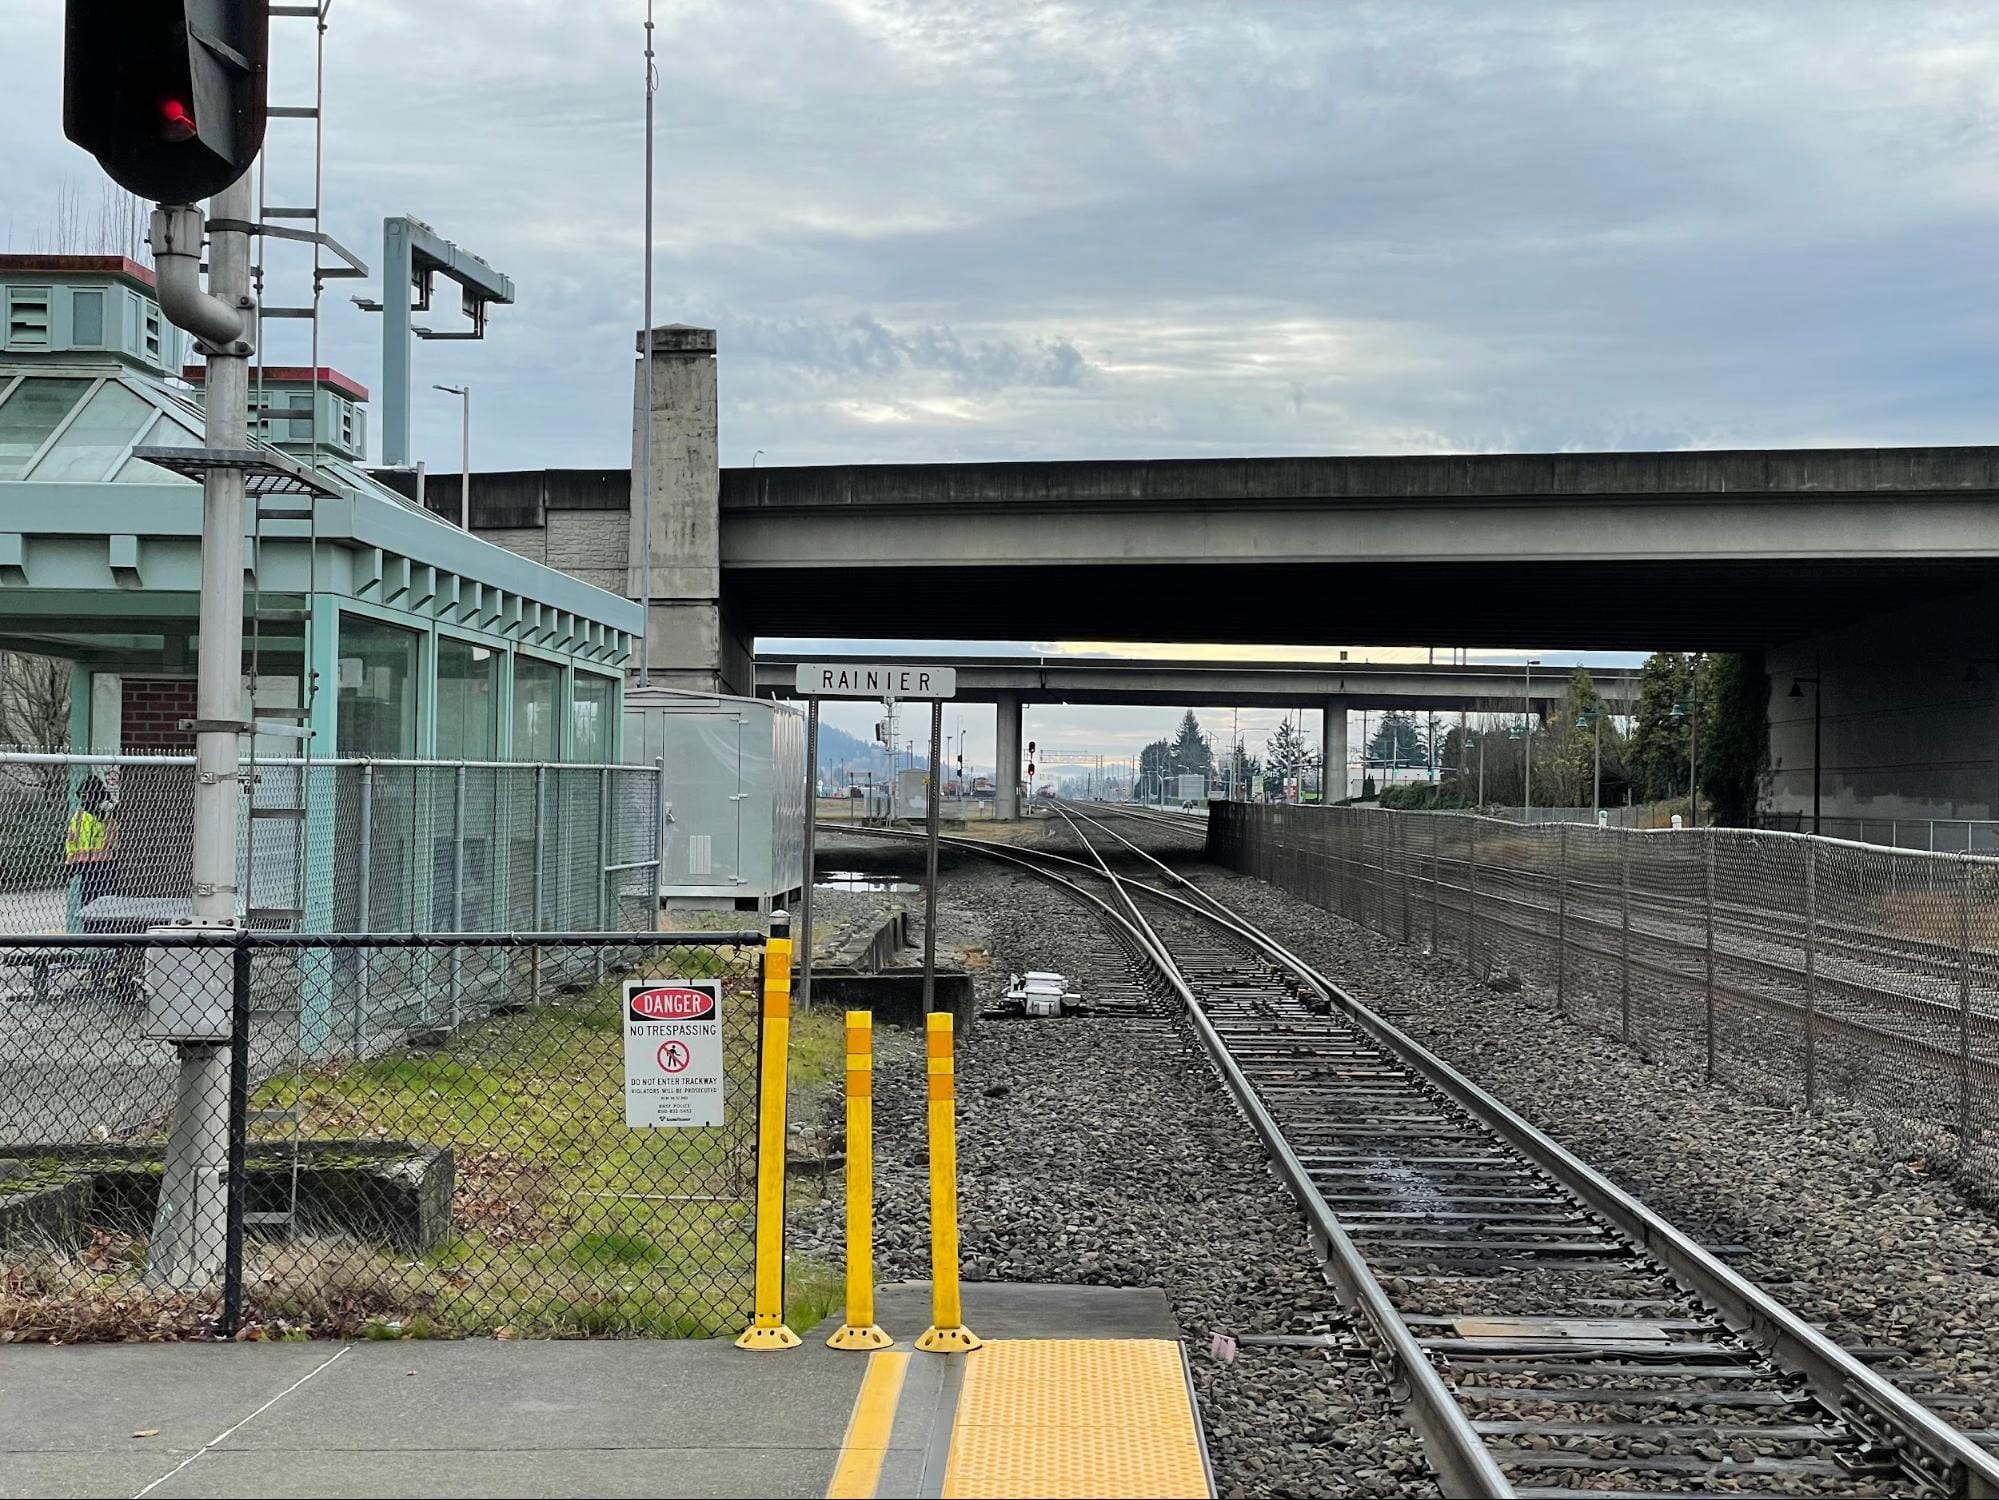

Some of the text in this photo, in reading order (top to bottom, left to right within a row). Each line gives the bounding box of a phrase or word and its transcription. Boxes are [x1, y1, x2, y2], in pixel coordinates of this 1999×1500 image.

[823, 670, 930, 691] RAINIER
[644, 995, 701, 1013] DANGER
[630, 1024, 717, 1036] NO TRESPASSING
[631, 1077, 718, 1086] DO NOT ENTER TRACKWAY
